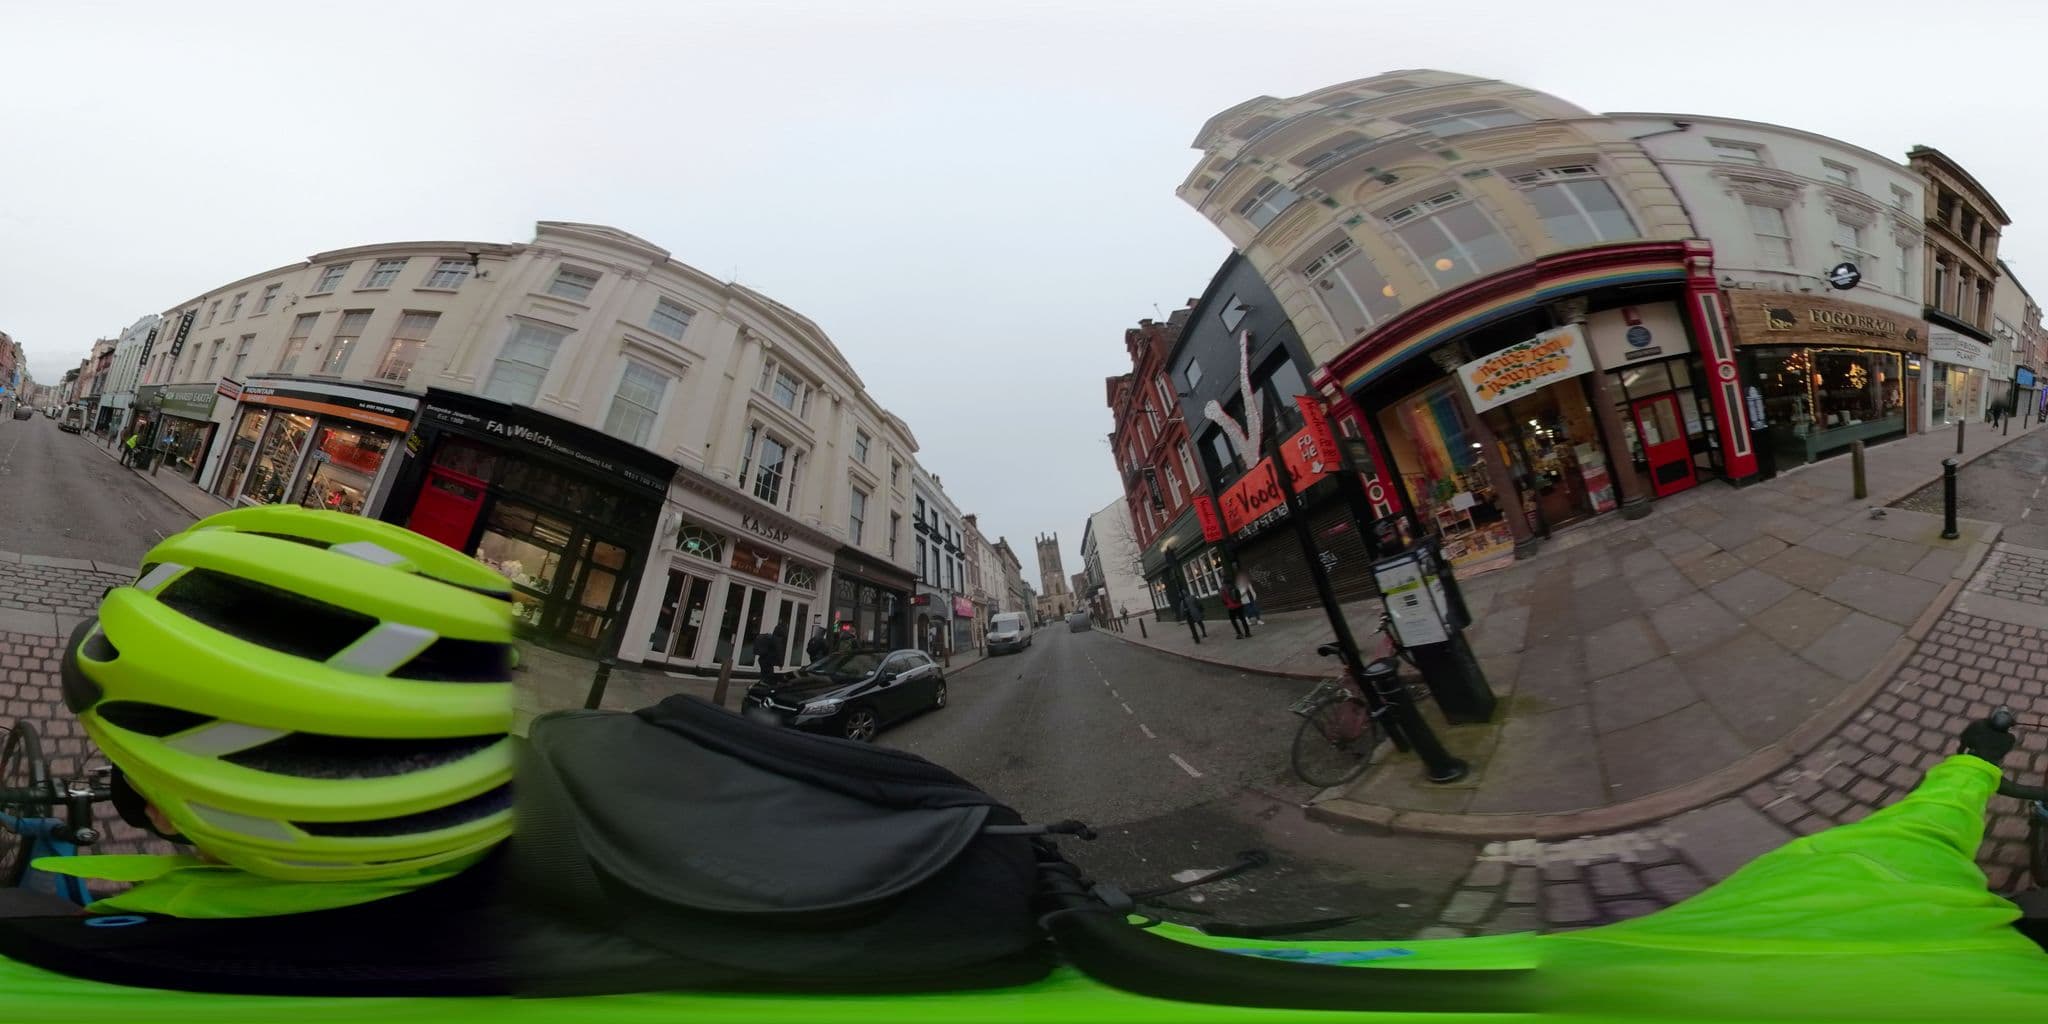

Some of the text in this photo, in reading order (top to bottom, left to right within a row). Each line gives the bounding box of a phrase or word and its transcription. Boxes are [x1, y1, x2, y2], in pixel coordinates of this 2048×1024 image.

[1808, 308, 1856, 326] FOGO
[1856, 315, 1897, 333] BRAZIL
[486, 420, 504, 434] FA
[514, 424, 554, 447] Welch
[1236, 464, 1303, 513] Voodu
[741, 513, 790, 545] KASSAP
